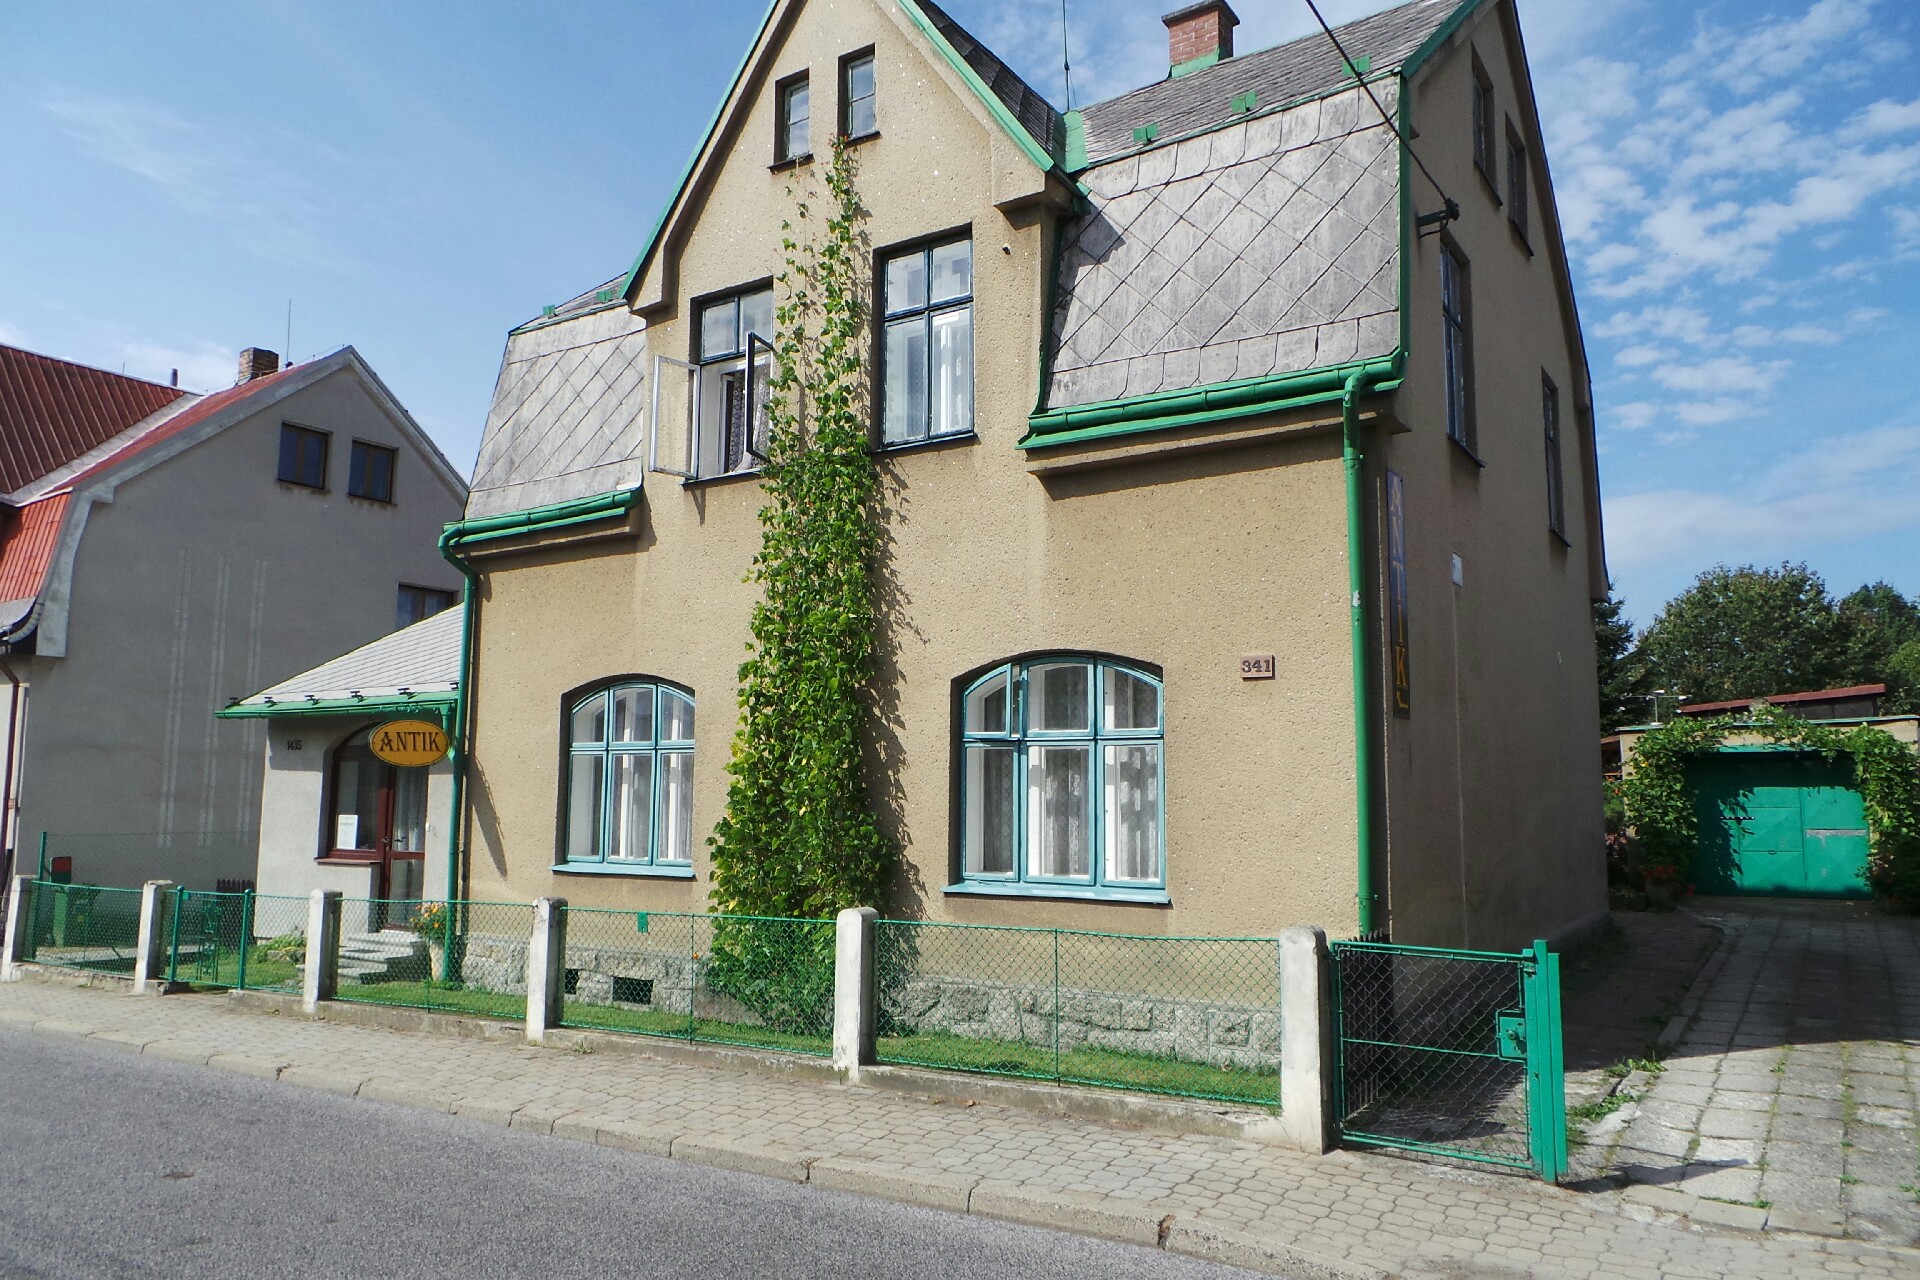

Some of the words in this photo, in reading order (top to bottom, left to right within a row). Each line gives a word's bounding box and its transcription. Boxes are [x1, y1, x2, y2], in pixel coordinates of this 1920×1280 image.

[1389, 476, 1408, 689] ANTIK
[1242, 660, 1271, 673] 341
[379, 731, 442, 752] ANTIK
